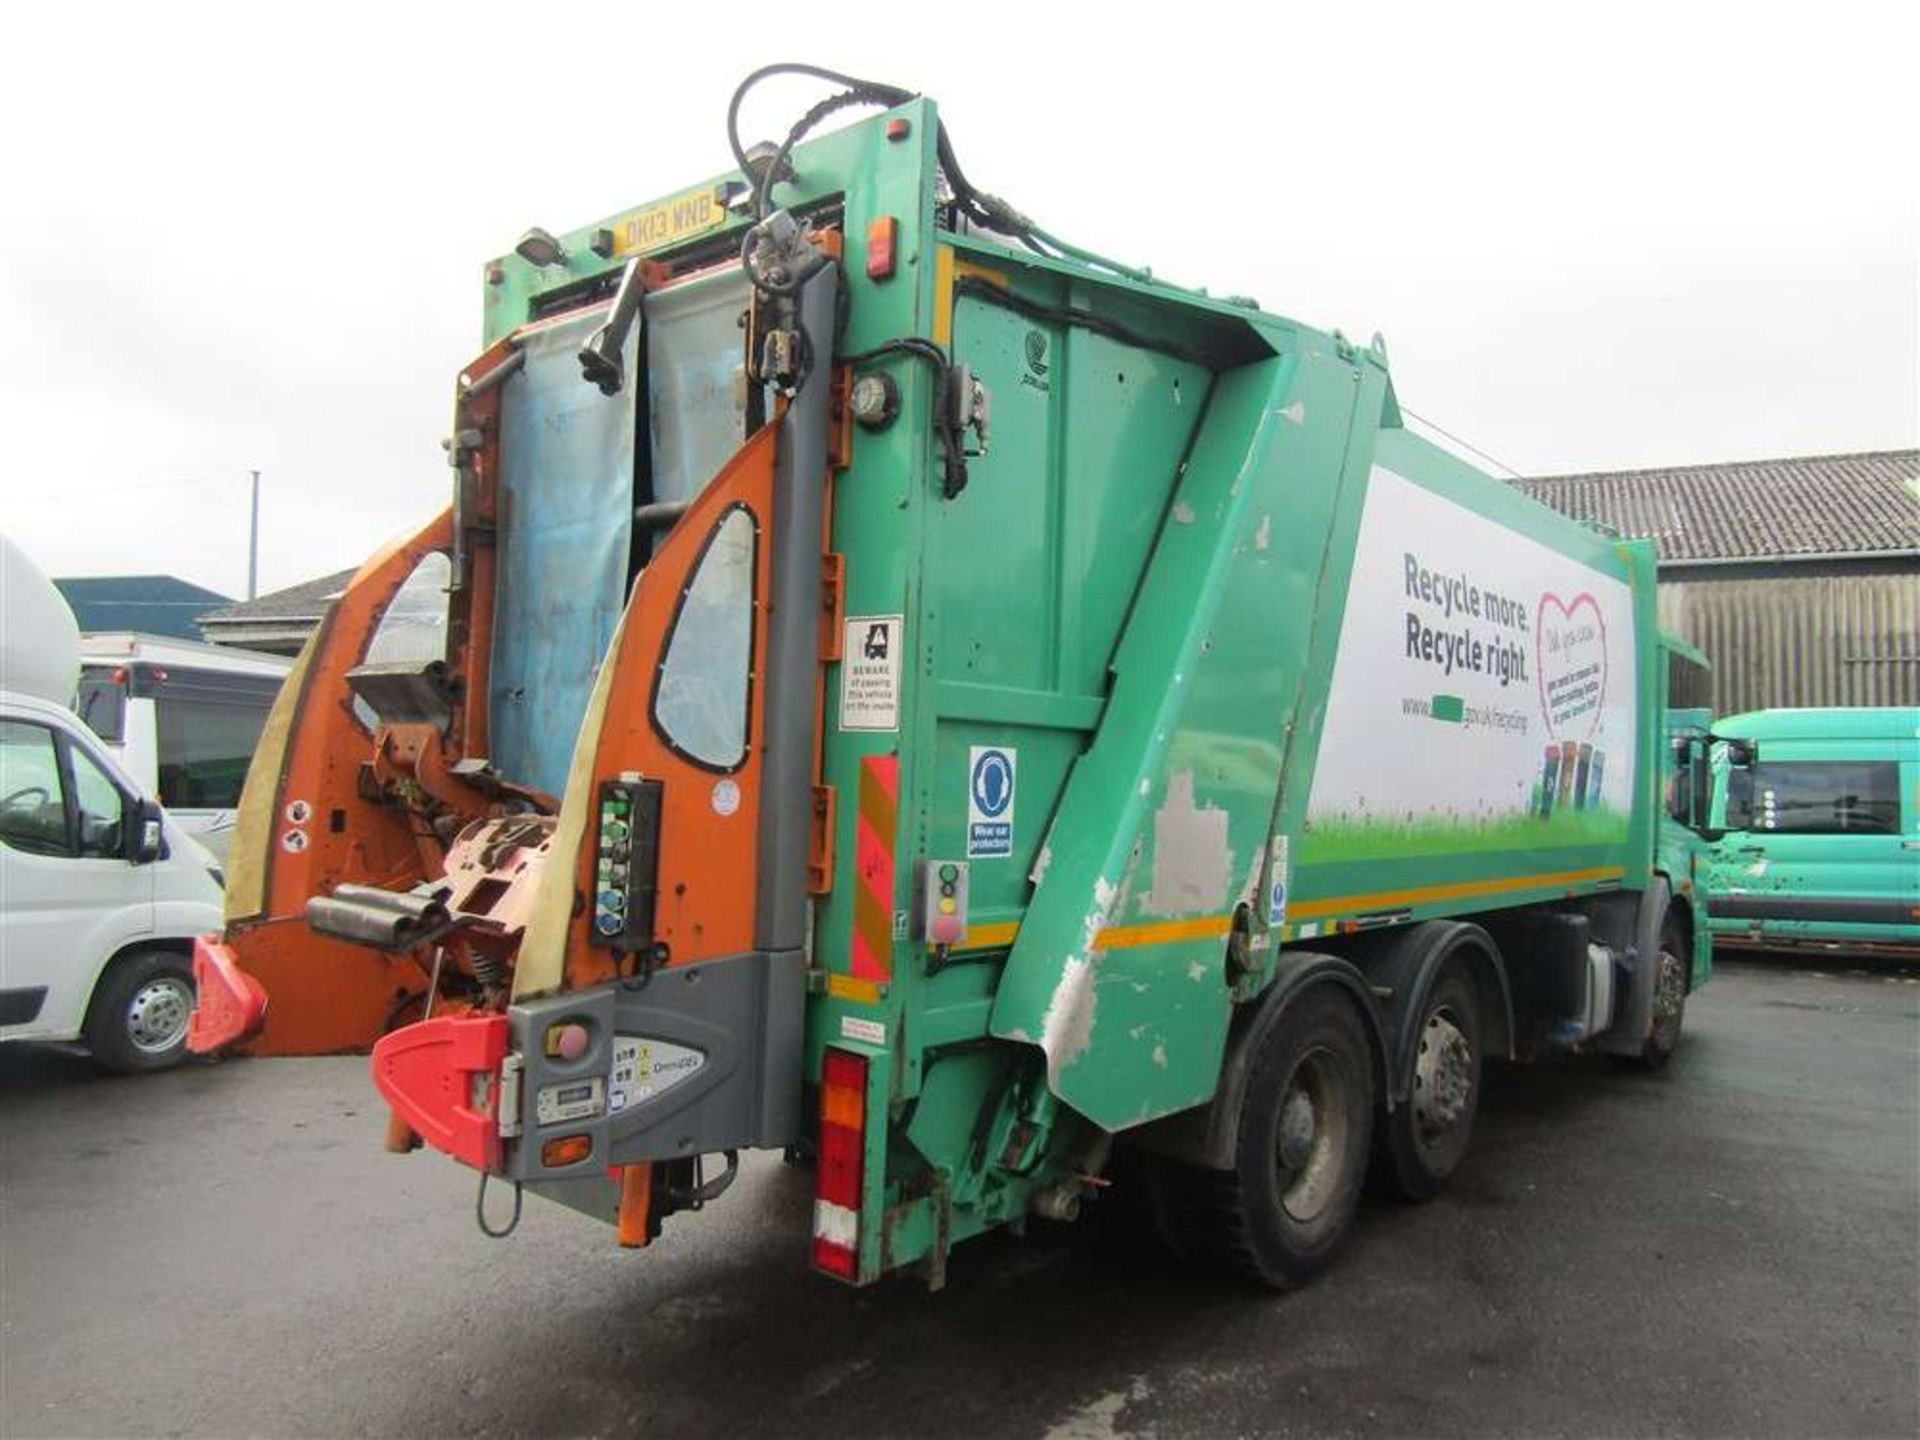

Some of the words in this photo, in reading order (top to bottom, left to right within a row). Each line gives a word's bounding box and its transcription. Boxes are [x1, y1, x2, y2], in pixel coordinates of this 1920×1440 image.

[1404, 552, 1481, 618] Recycle
[1484, 589, 1531, 632] more.
[853, 665, 890, 675] BEWARE
[1405, 612, 1483, 676] Recycle
[1486, 633, 1529, 687] right.
[974, 825, 994, 837] Wear
